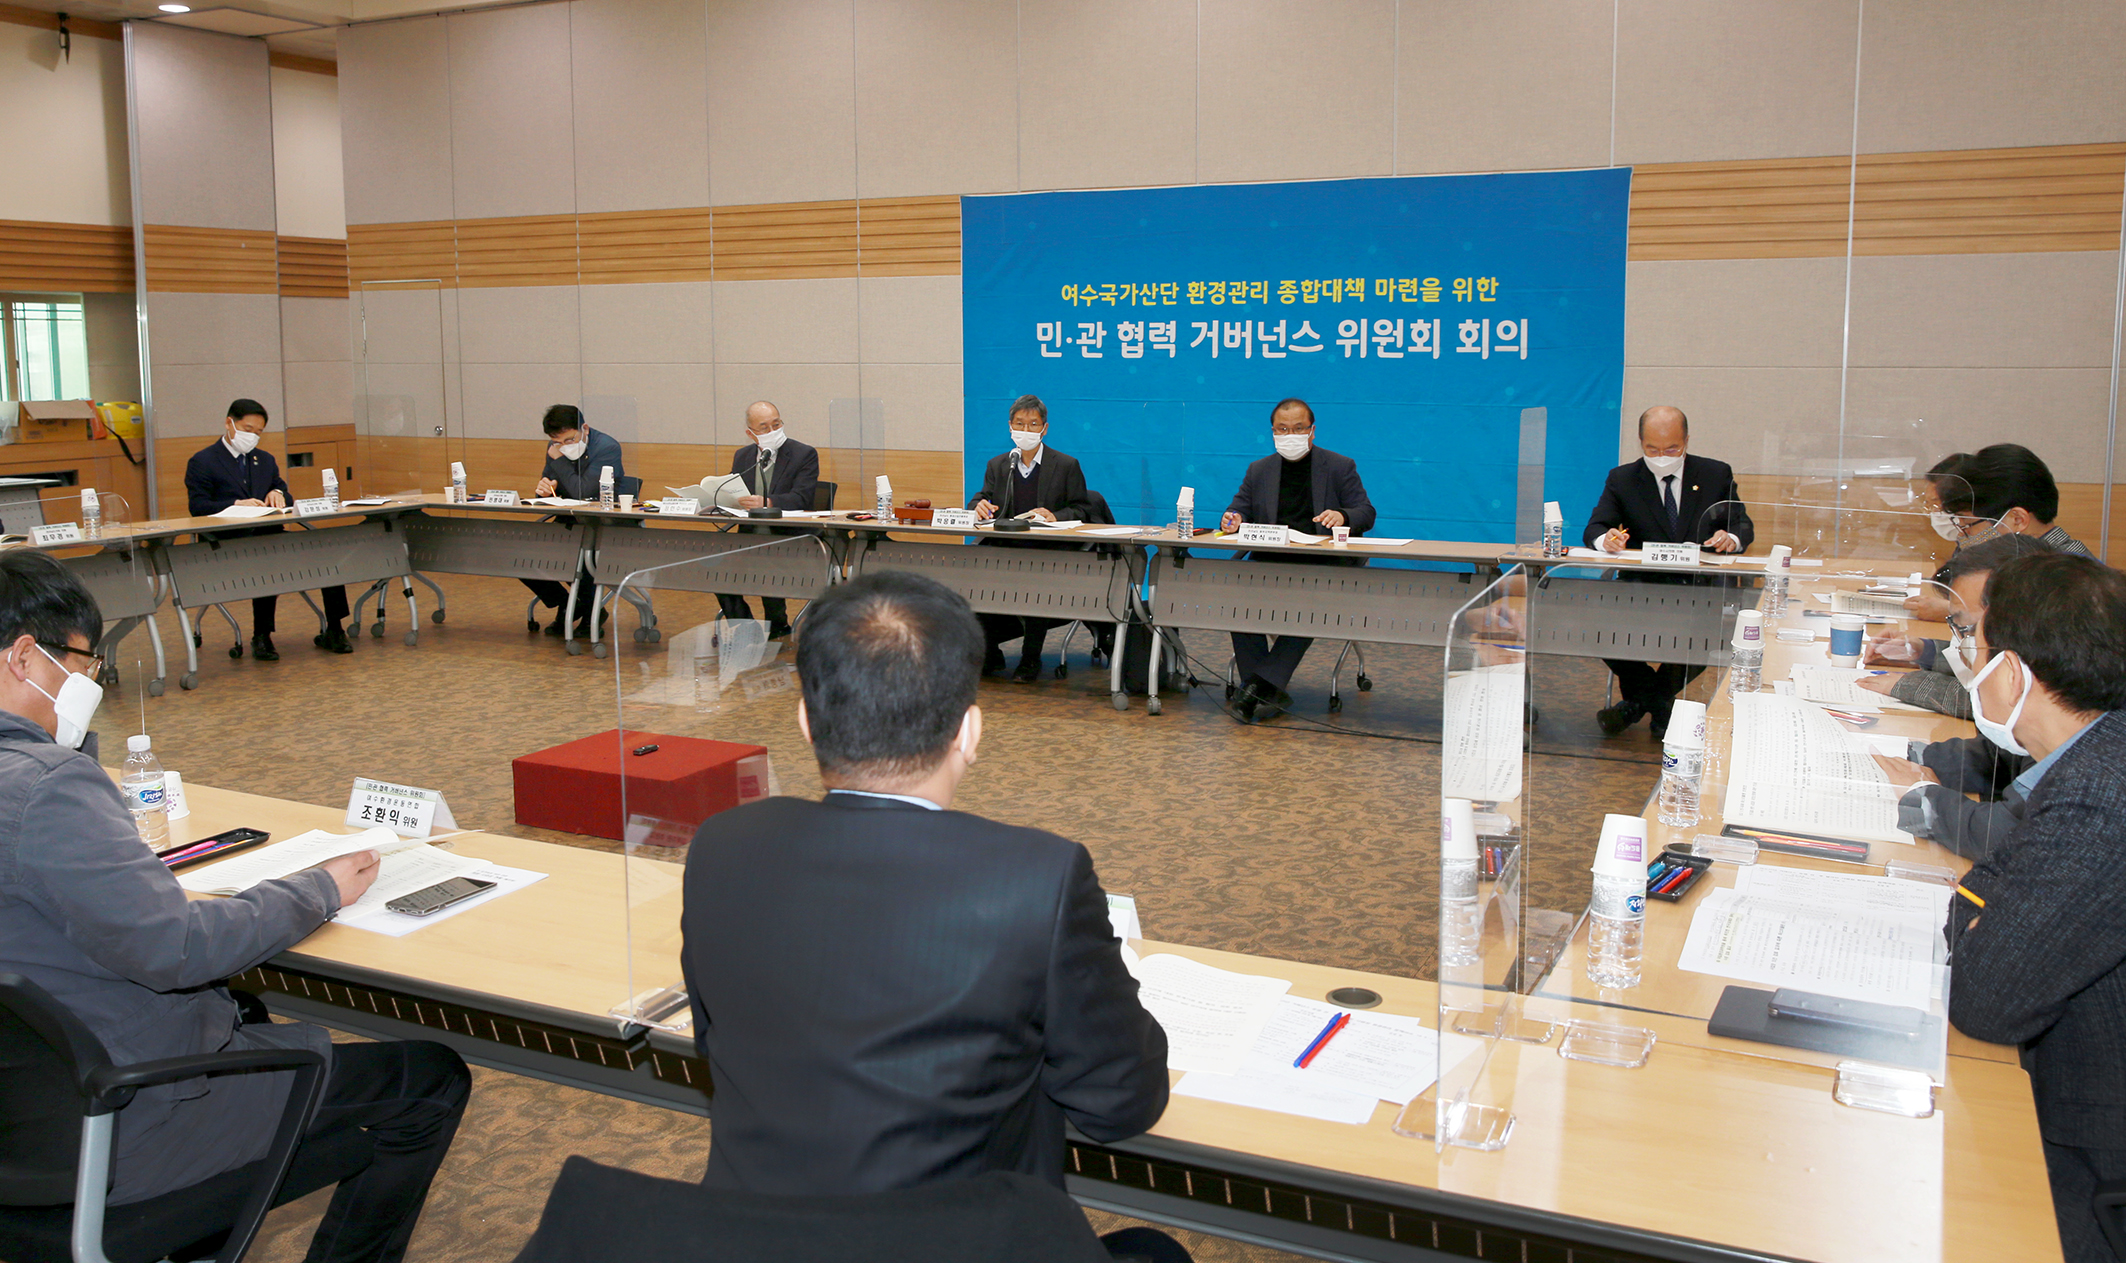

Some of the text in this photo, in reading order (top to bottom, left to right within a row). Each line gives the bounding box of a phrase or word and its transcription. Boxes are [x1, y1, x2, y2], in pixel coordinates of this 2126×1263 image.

[1061, 276, 1500, 307] 여수국가산단 환경관리 종합대책 마련을 위한
[1036, 318, 1528, 360] 민·관 협력 거버넌스 위원회 회의
[1652, 553, 1677, 561] 김행기
[361, 805, 418, 828] 조환익 위원
